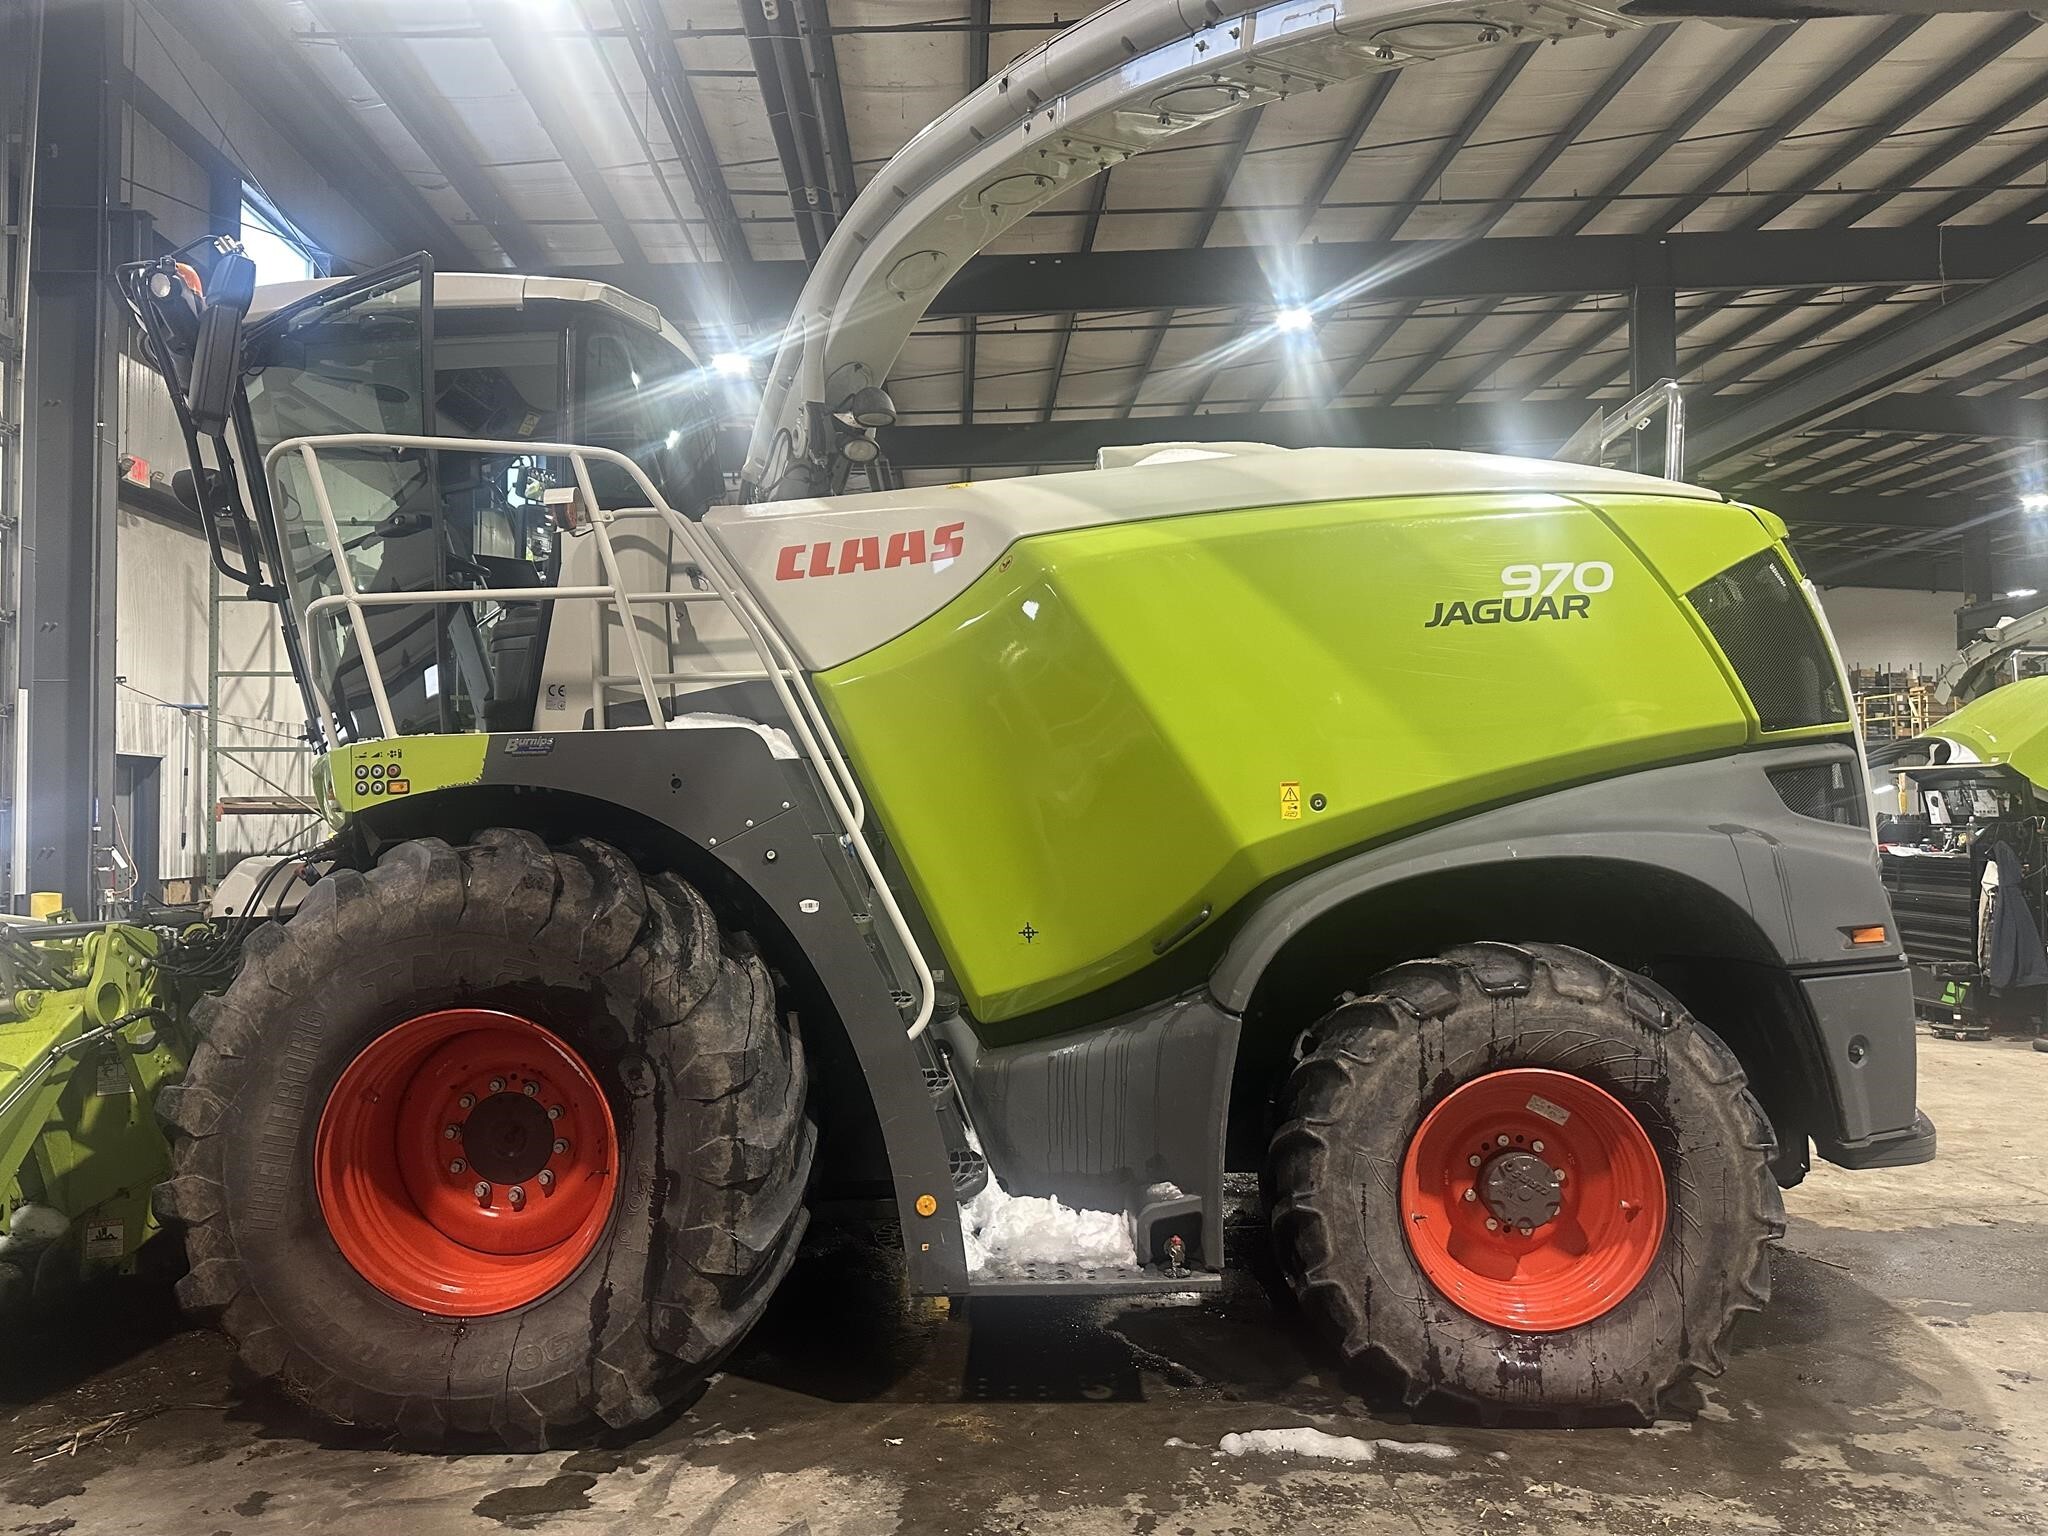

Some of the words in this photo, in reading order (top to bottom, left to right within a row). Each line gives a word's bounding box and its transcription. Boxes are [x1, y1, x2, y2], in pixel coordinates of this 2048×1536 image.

[776, 521, 965, 581] CLAAS
[1501, 561, 1614, 598] 970
[1424, 594, 1591, 628] JAGUAR
[504, 735, 554, 752] Burnips
[246, 1006, 329, 1232] TRELLEBORG
